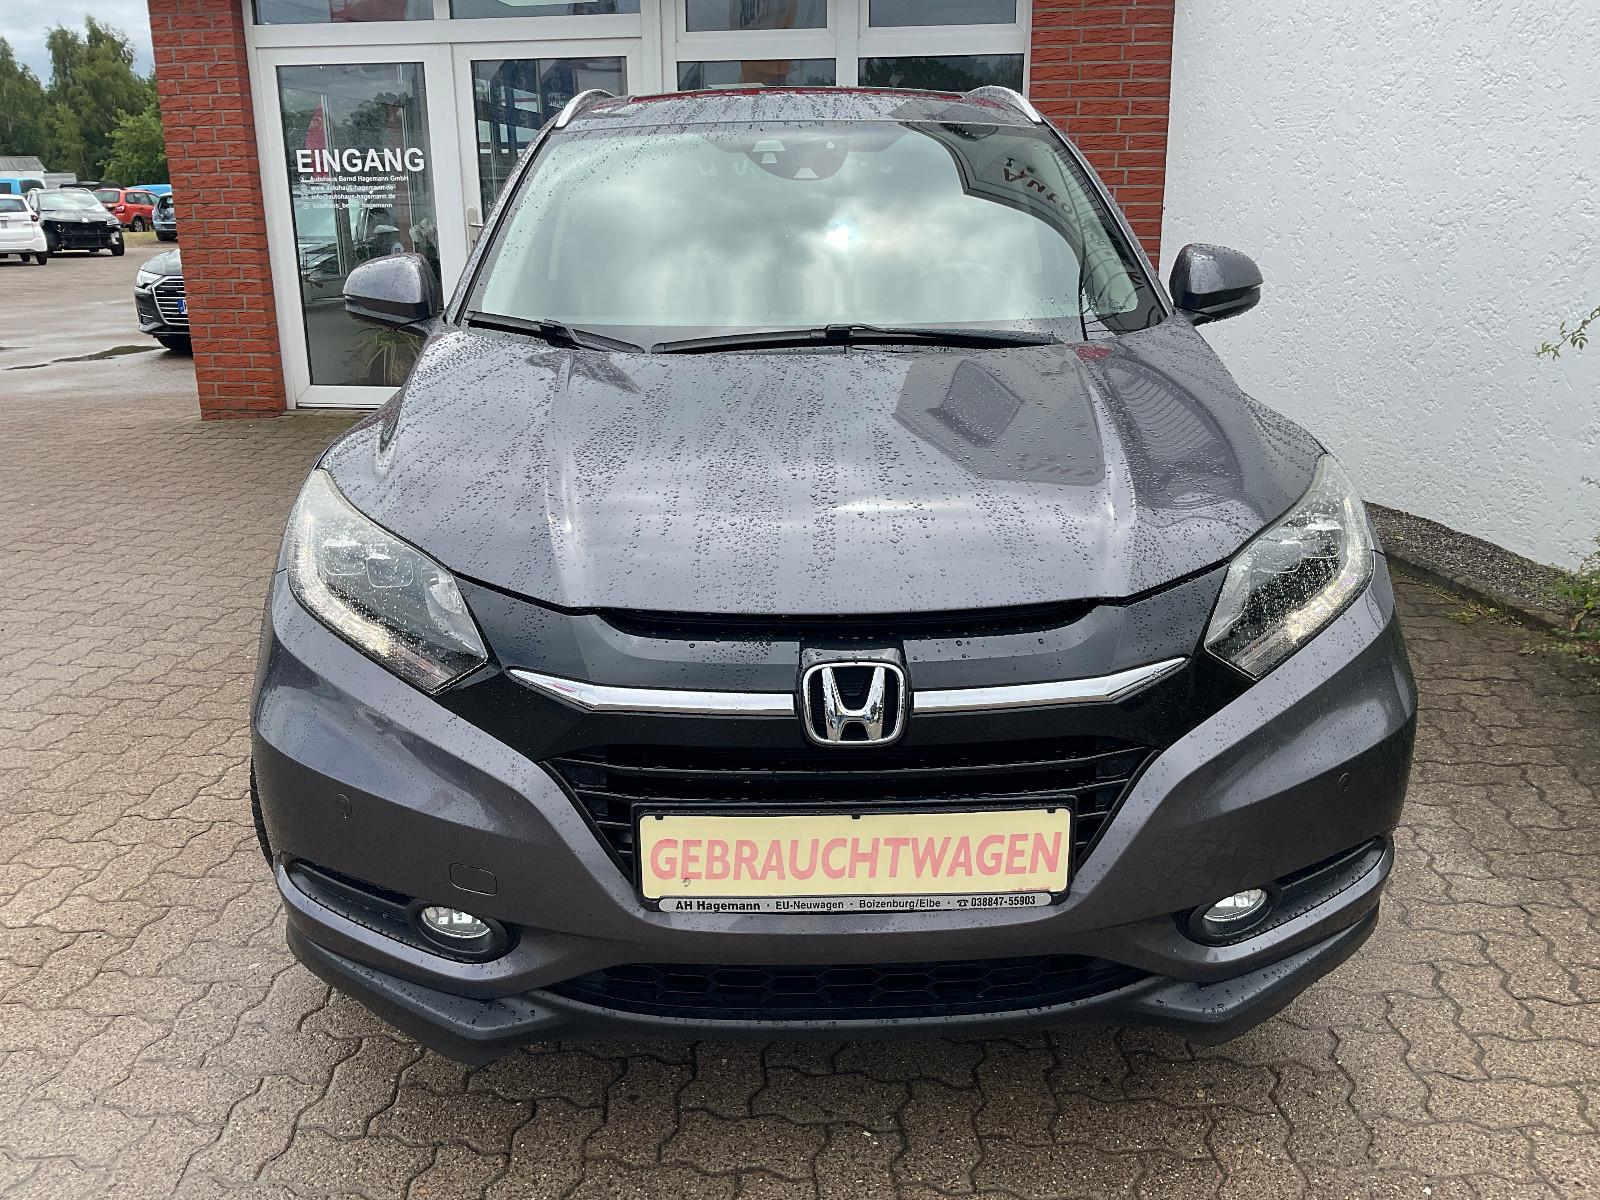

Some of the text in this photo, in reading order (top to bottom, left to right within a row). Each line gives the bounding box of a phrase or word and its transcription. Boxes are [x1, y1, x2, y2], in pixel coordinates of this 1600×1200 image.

[295, 147, 425, 173] EINGANG
[357, 175, 389, 183] Hagemann
[650, 831, 1062, 881] GEBRAUCHTWAGEN
[675, 895, 1036, 912] AH Hagemann EU-Neuwagen Boizenburg/Elbe 038847-55903
